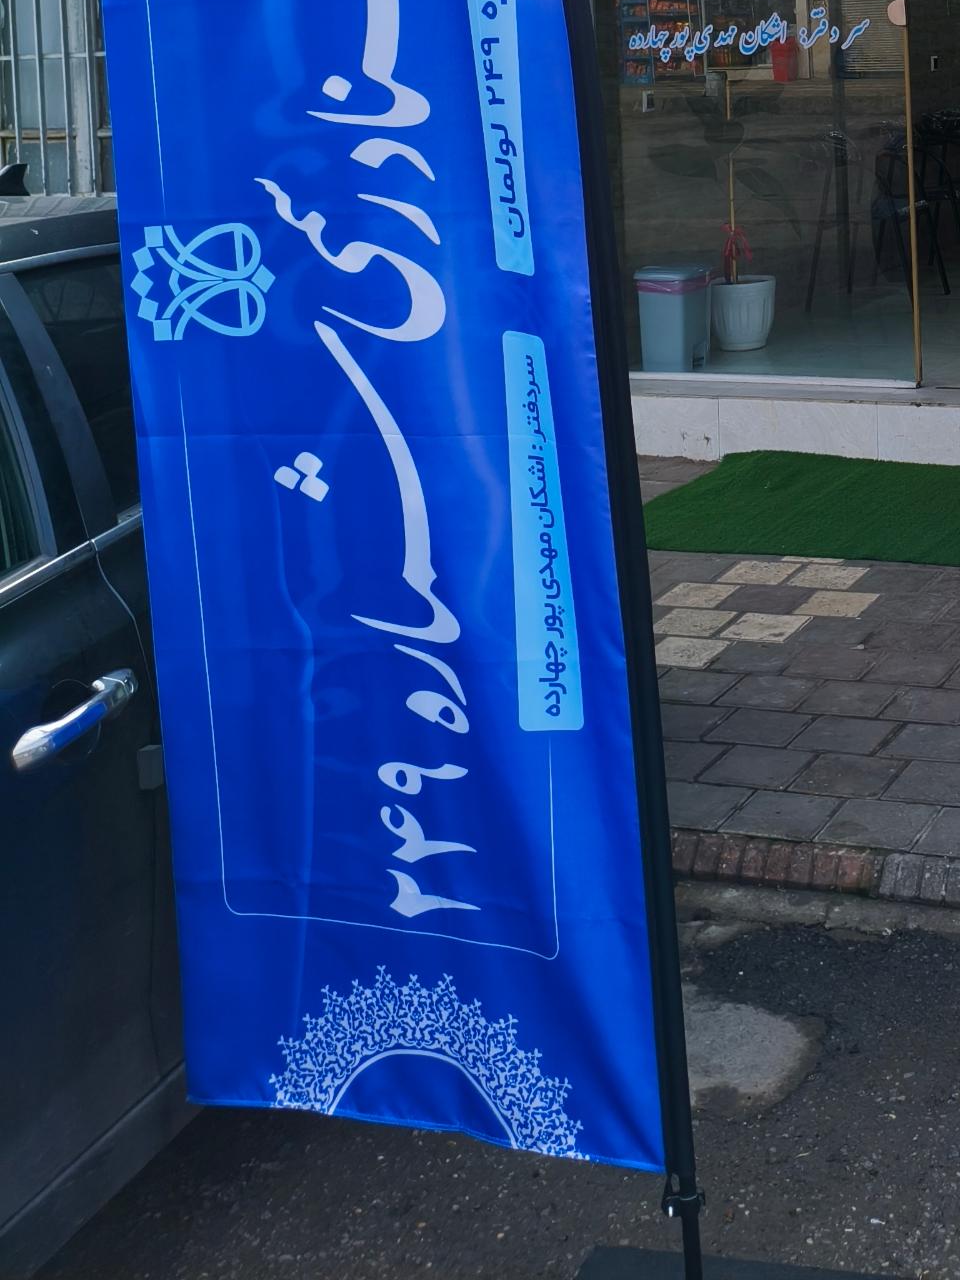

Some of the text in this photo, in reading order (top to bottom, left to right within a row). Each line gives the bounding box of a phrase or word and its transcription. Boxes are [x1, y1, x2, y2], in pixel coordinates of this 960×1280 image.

[629, 25, 671, 62] چهارده
[670, 26, 694, 61] پور
[739, 12, 787, 55] اشکان
[480, 36, 506, 107] ۲۴۹
[491, 122, 526, 239] لولمان
[254, 177, 446, 342] رسمی
[273, 320, 470, 734] شماره
[528, 455, 554, 528] اشکان
[539, 531, 562, 600] مهدی
[543, 602, 567, 639] پور
[538, 640, 568, 718] چهارده
[377, 762, 479, 918] ۲۴۹
